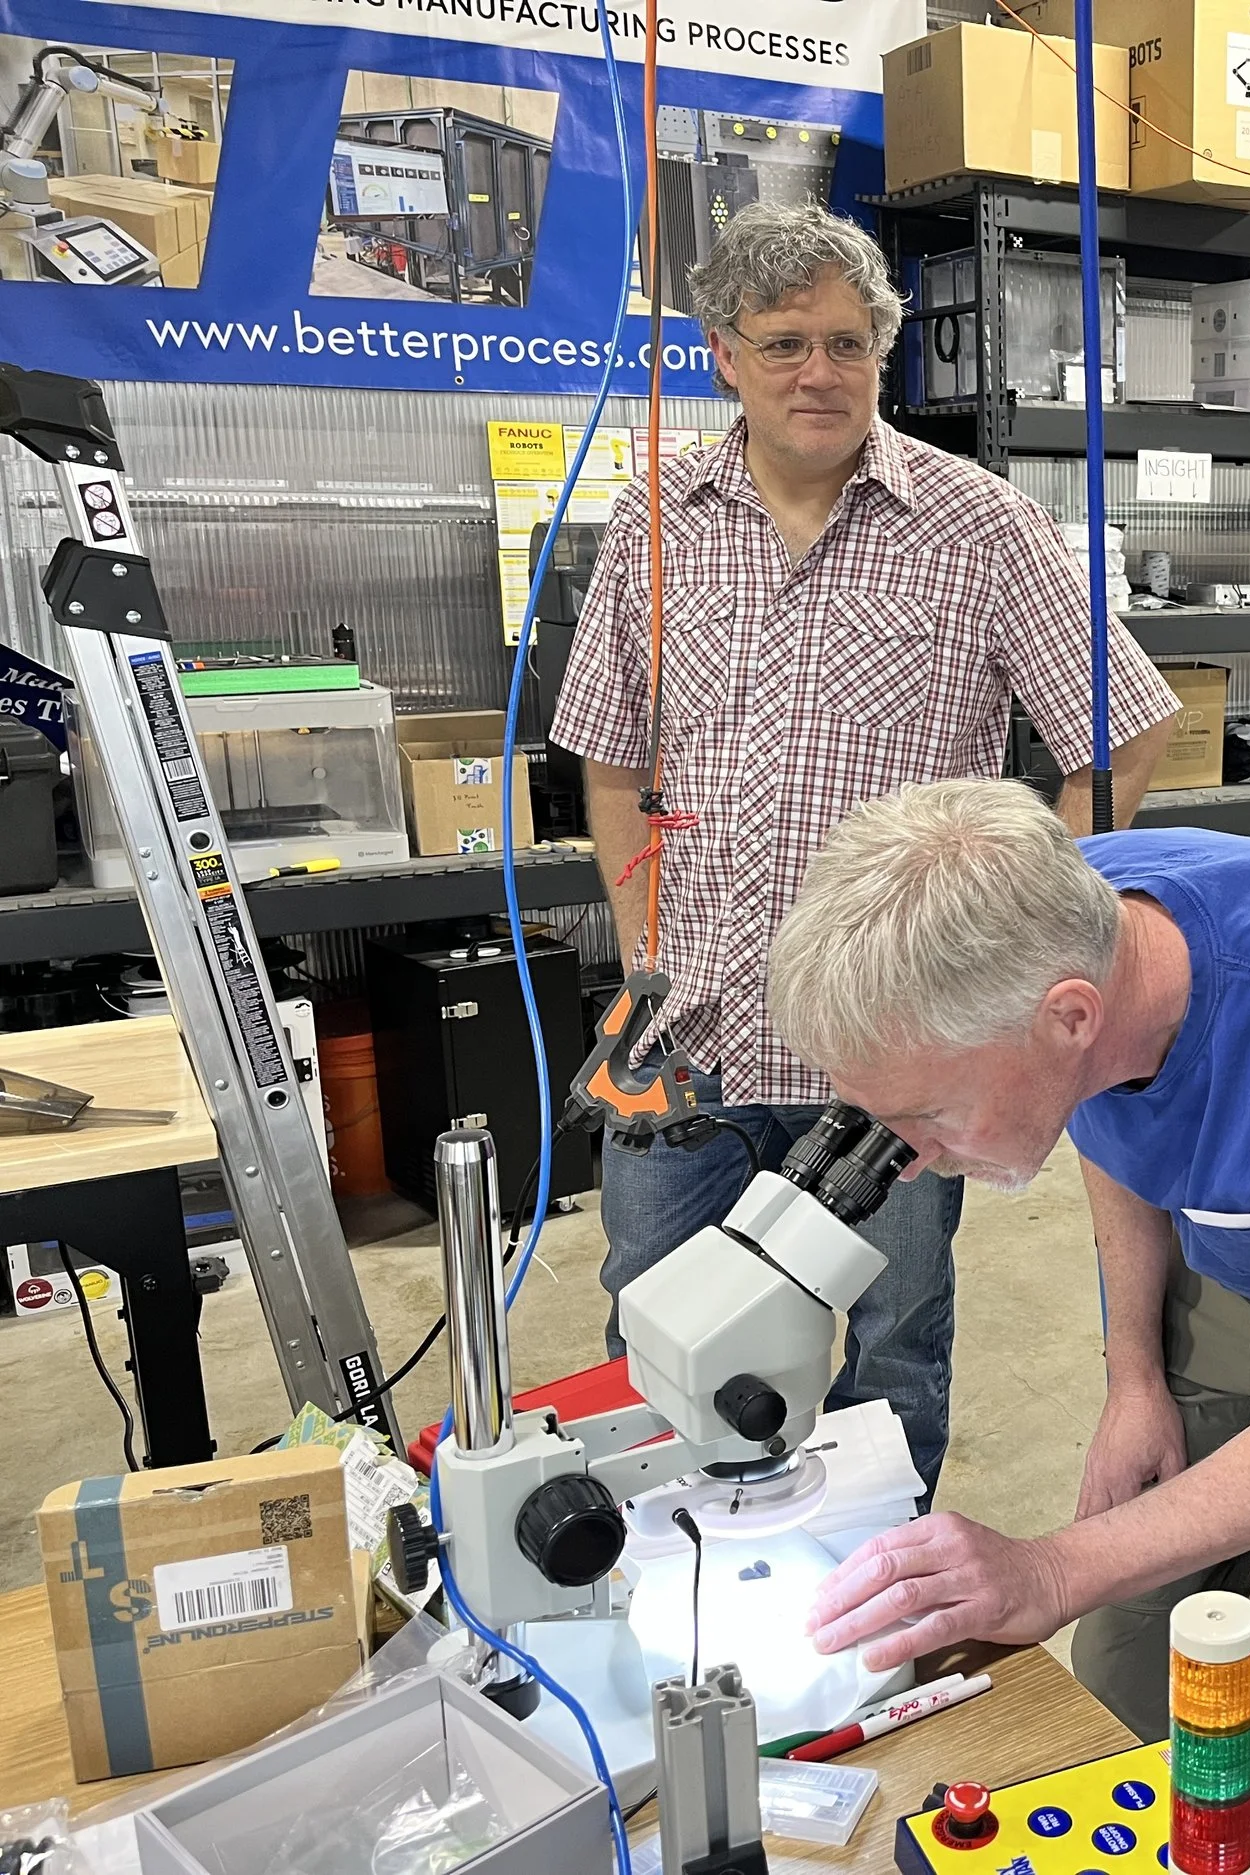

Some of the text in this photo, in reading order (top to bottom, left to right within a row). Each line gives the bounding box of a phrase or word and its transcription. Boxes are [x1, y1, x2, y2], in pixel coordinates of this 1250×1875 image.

[688, 22, 850, 66] PROCESSES
[146, 310, 712, 372] www.betterprocess.com
[498, 427, 553, 439] FANUC
[509, 442, 544, 450] ROBOTS
[1144, 458, 1208, 480] INSIGHT
[193, 858, 218, 871] 300
[18, 1291, 52, 1303] WOLVERINE
[346, 1356, 378, 1428] GORILA
[146, 1606, 334, 1648] STEPPERONLINE
[889, 1700, 919, 1720] EXPO
[1122, 1782, 1146, 1809] PLASMA
[1037, 1815, 1052, 1832] FWD
[1046, 1813, 1060, 1828] REV
[1098, 1827, 1121, 1853] MOTOR
